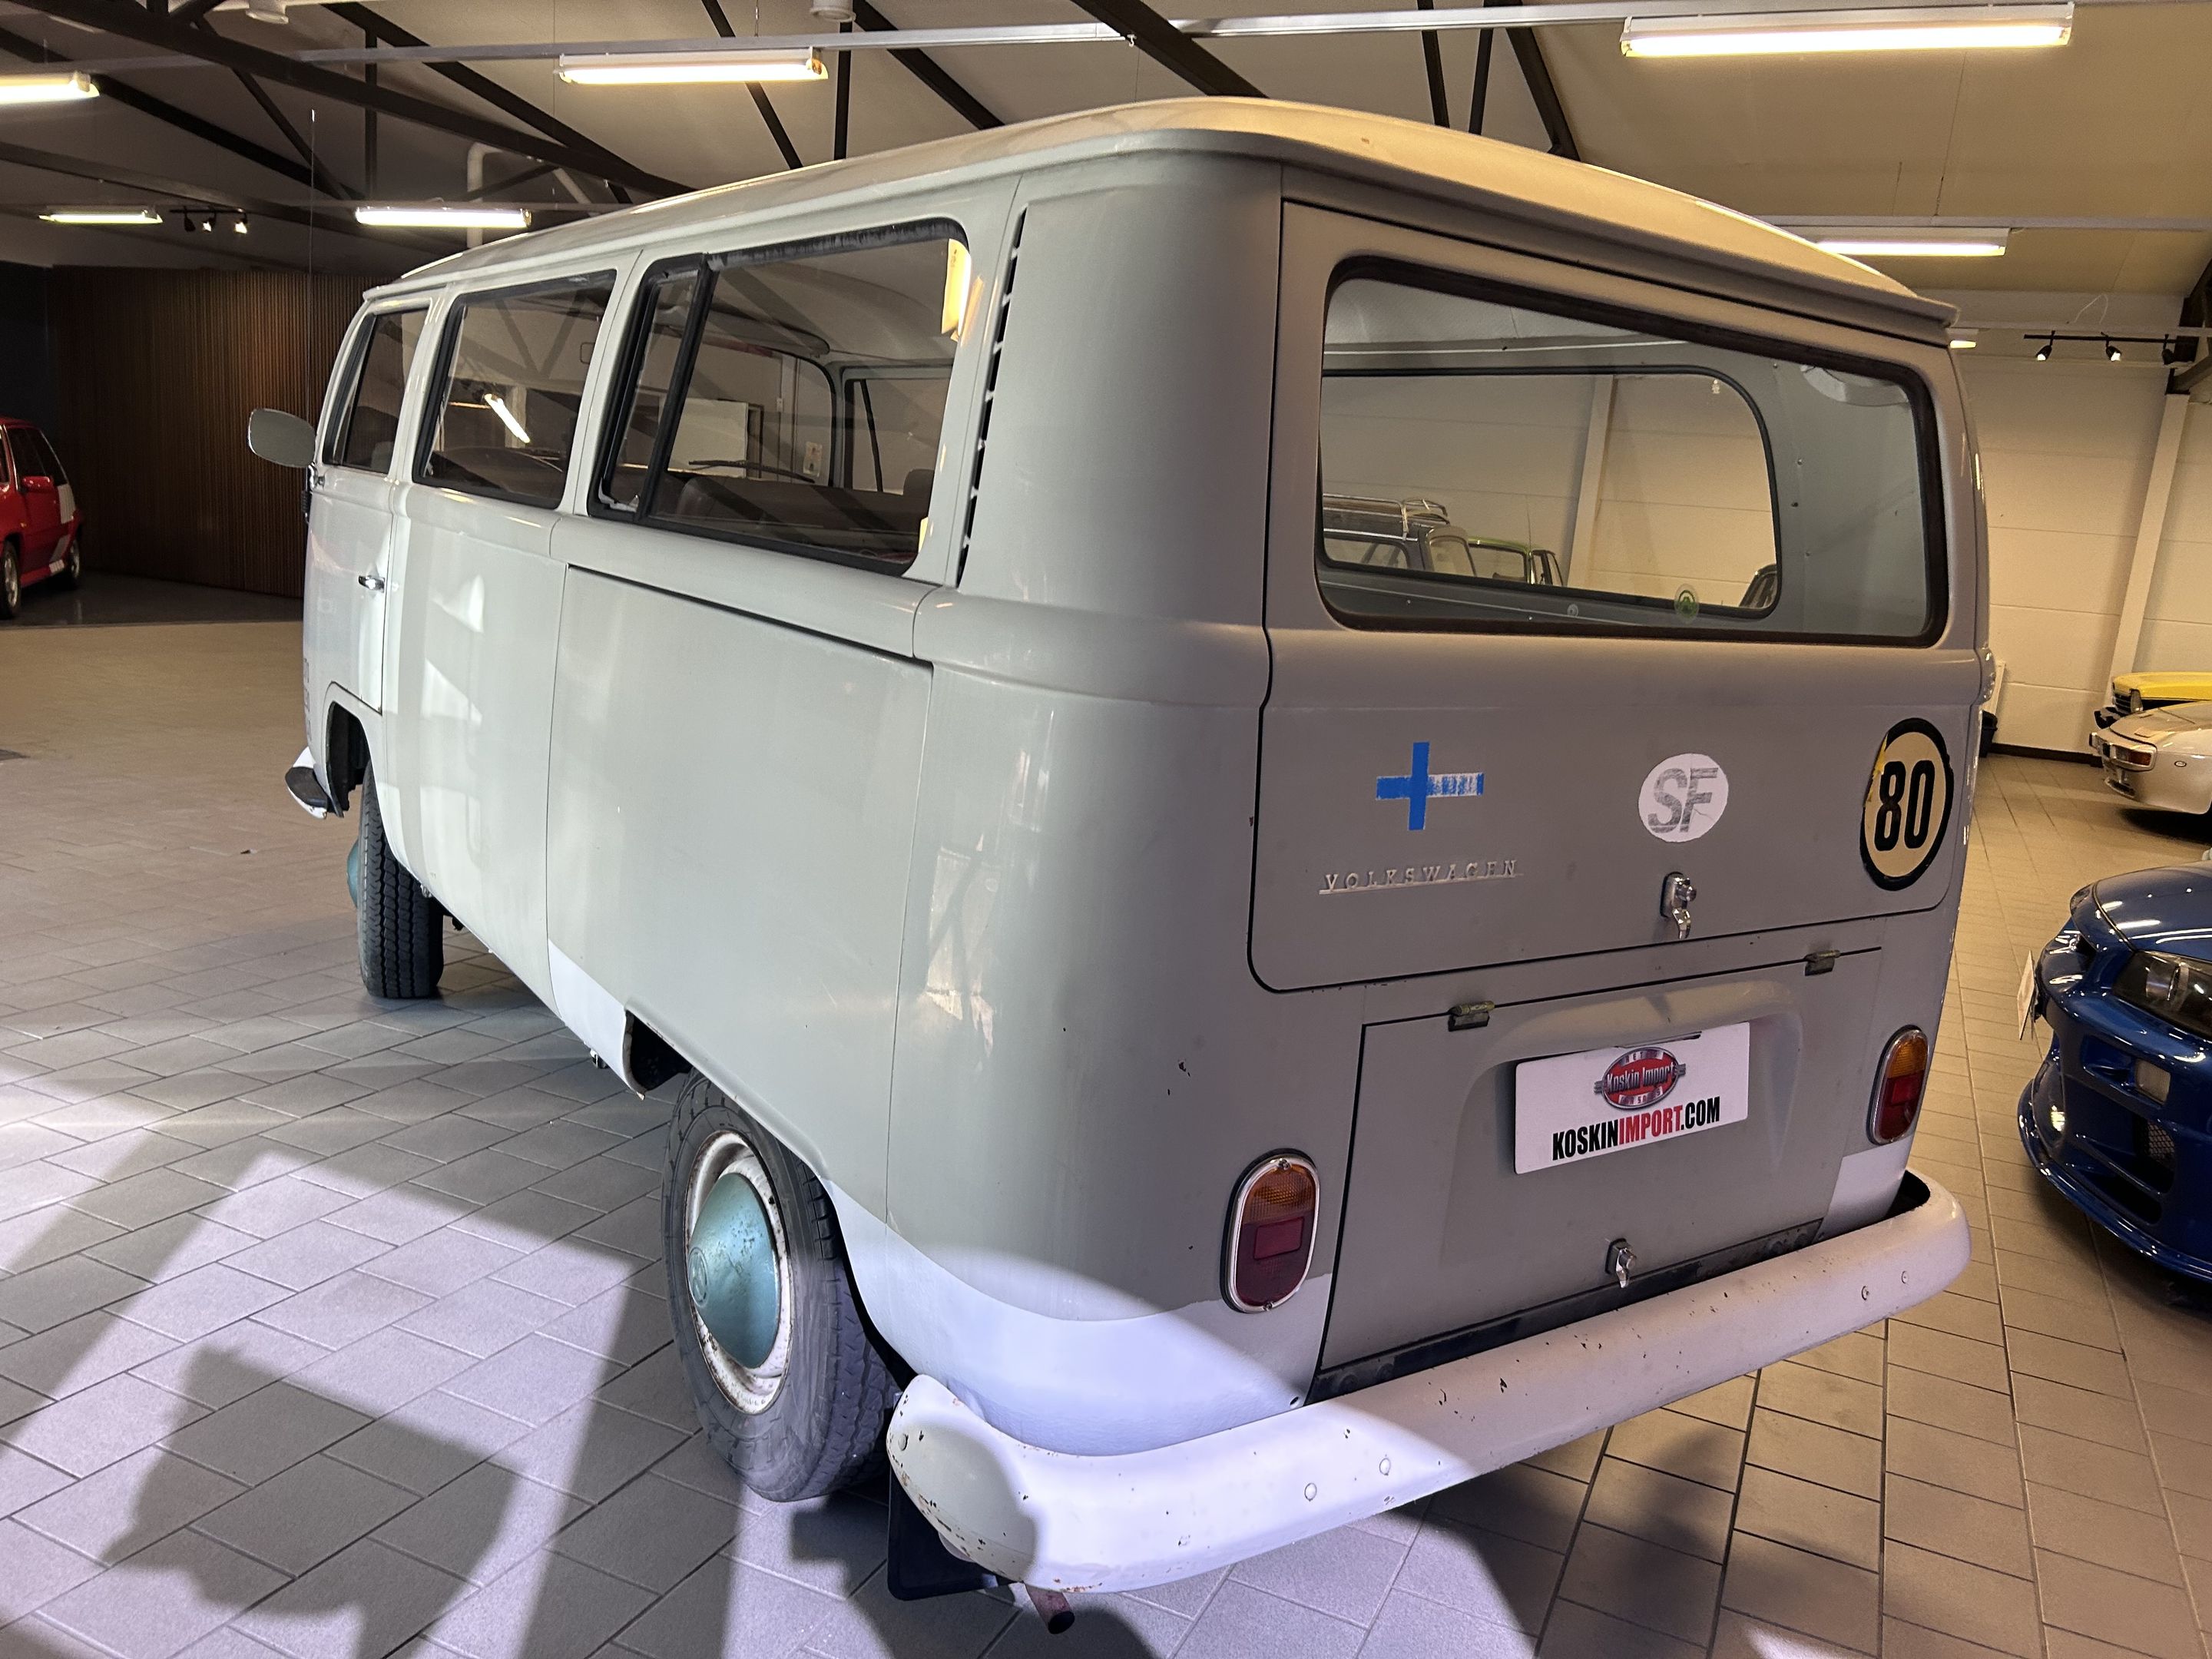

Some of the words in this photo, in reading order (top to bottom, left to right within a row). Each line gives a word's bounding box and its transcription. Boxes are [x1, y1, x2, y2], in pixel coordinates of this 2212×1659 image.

[1648, 768, 1718, 833] SF
[1874, 760, 1935, 851] 80
[1325, 860, 1518, 891] VOLKSWAGEN
[1607, 1068, 1640, 1092] Koskin
[1642, 1061, 1674, 1086] Import
[1552, 1096, 1720, 1161] KOSKINIMPORT.COM
